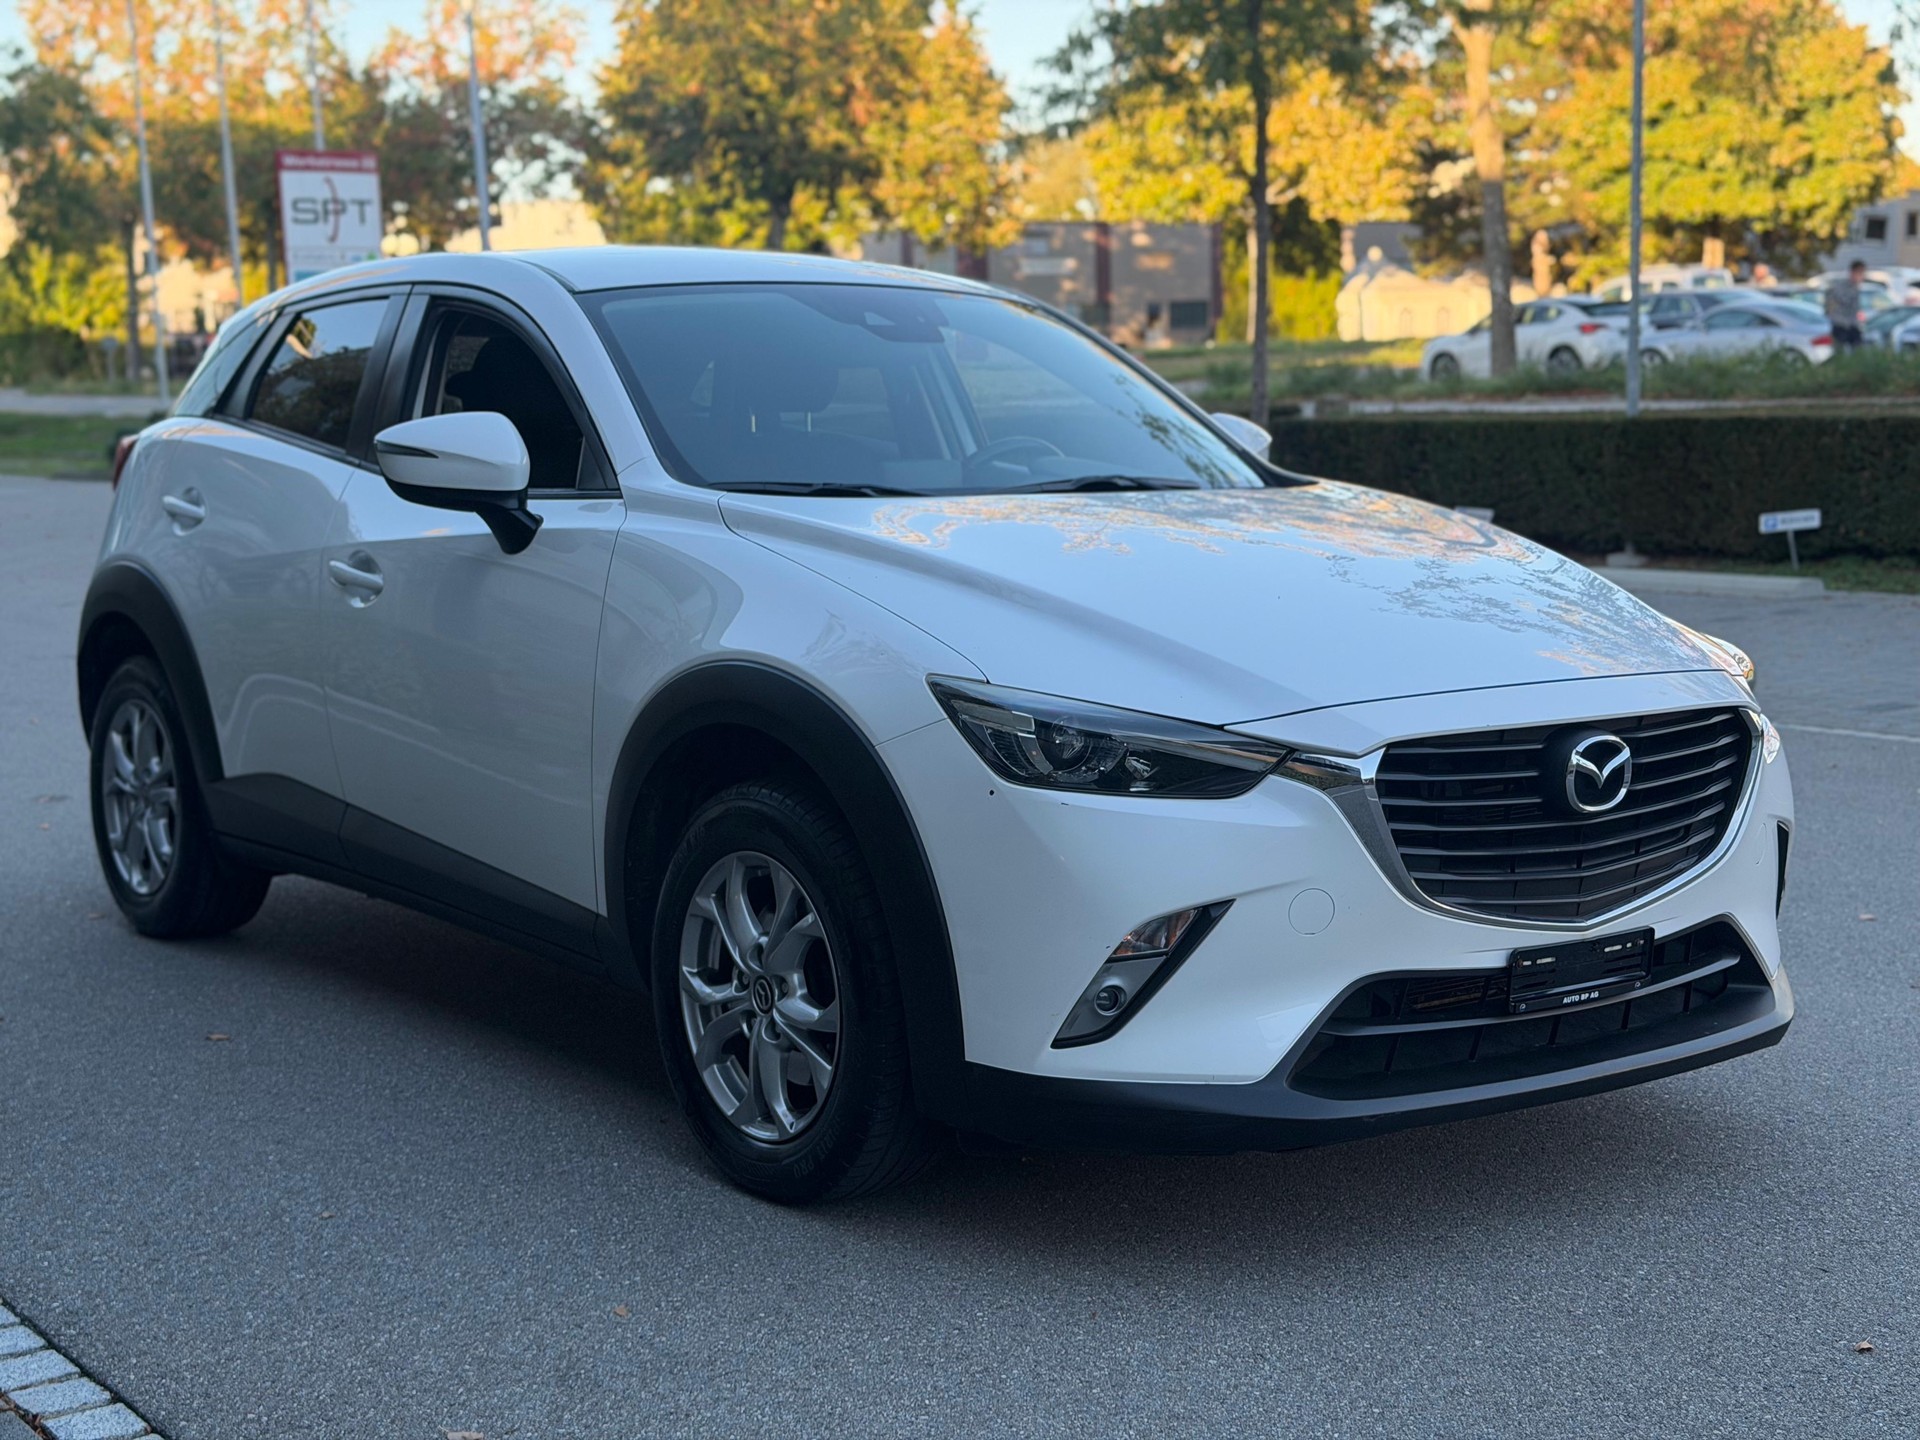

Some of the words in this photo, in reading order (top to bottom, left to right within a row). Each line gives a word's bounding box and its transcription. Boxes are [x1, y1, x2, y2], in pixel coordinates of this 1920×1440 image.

[291, 198, 373, 225] SPT
[1563, 995, 1580, 1004] AUTO
[1590, 991, 1599, 999] AG
